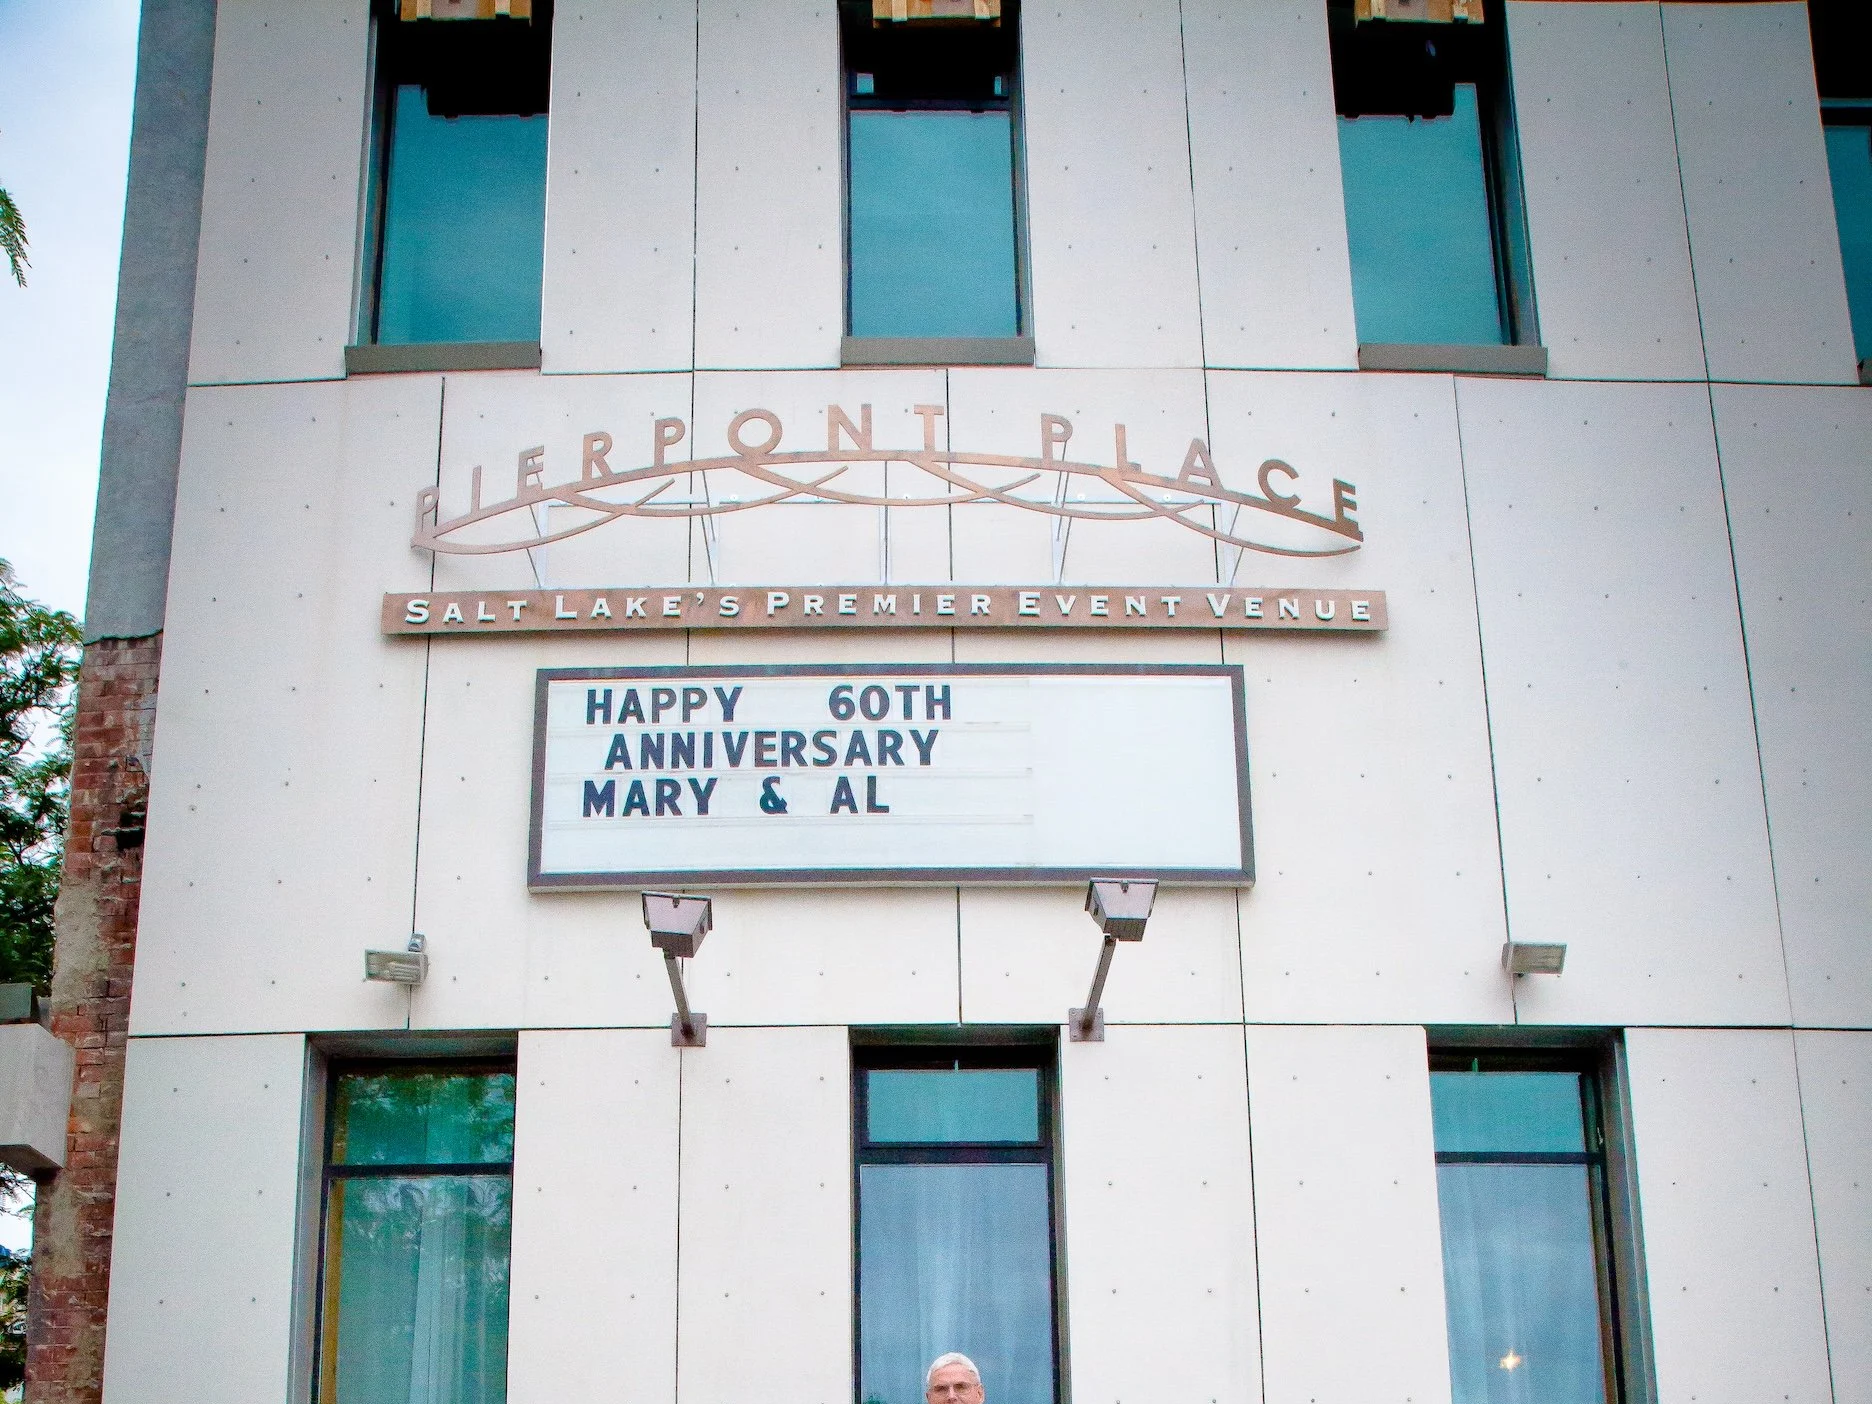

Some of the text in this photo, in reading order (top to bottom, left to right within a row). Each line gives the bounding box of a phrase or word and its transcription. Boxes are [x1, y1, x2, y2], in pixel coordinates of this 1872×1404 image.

[411, 403, 1364, 541] PIERPONT PLACE
[404, 590, 1371, 624] SALT LAKE'S PREMIER EVENT VENUE
[586, 684, 952, 725] HAPPY 60TH
[604, 729, 939, 771] ANNIVERSARY
[582, 775, 890, 818] MARY & AL
